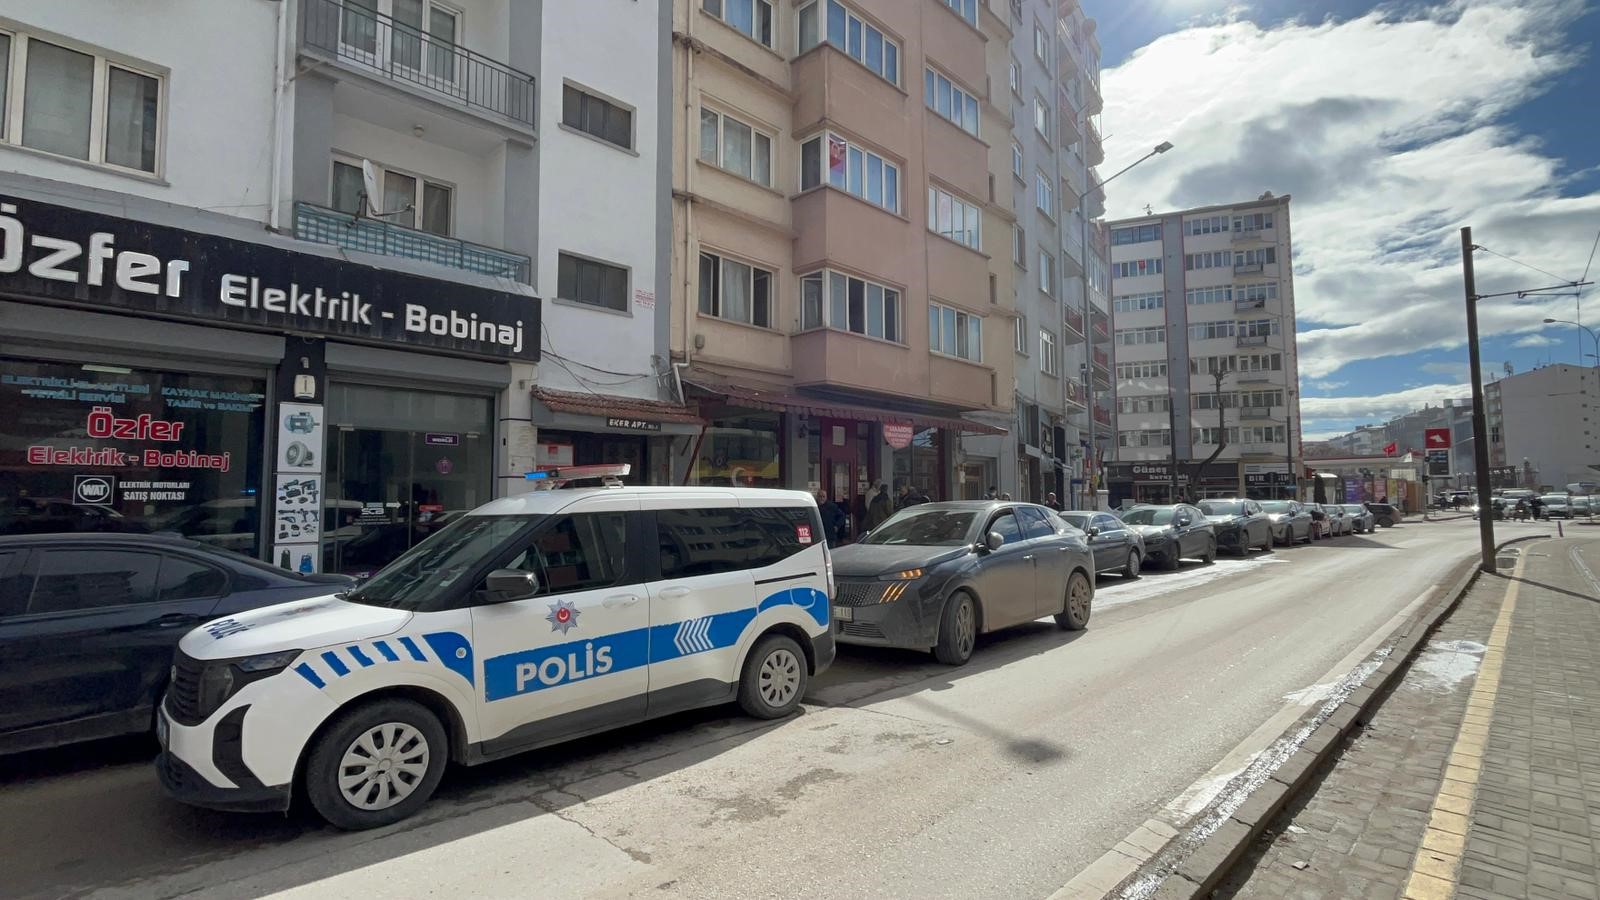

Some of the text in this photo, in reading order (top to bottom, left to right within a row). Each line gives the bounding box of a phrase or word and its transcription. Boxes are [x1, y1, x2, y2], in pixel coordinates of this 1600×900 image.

[220, 273, 372, 326] Elektrik
[381, 311, 394, 319] -
[405, 303, 523, 353] Bobinaj
[87, 406, 184, 441] Özfer
[28, 446, 126, 467] Elektrik
[144, 449, 230, 473] Bobinaj
[82, 484, 106, 496] WAT
[119, 480, 151, 489] ELEKTRİK
[123, 491, 185, 502] SATIŞ NOKTASI
[798, 527, 809, 537] 112
[515, 642, 613, 692] POLİS
